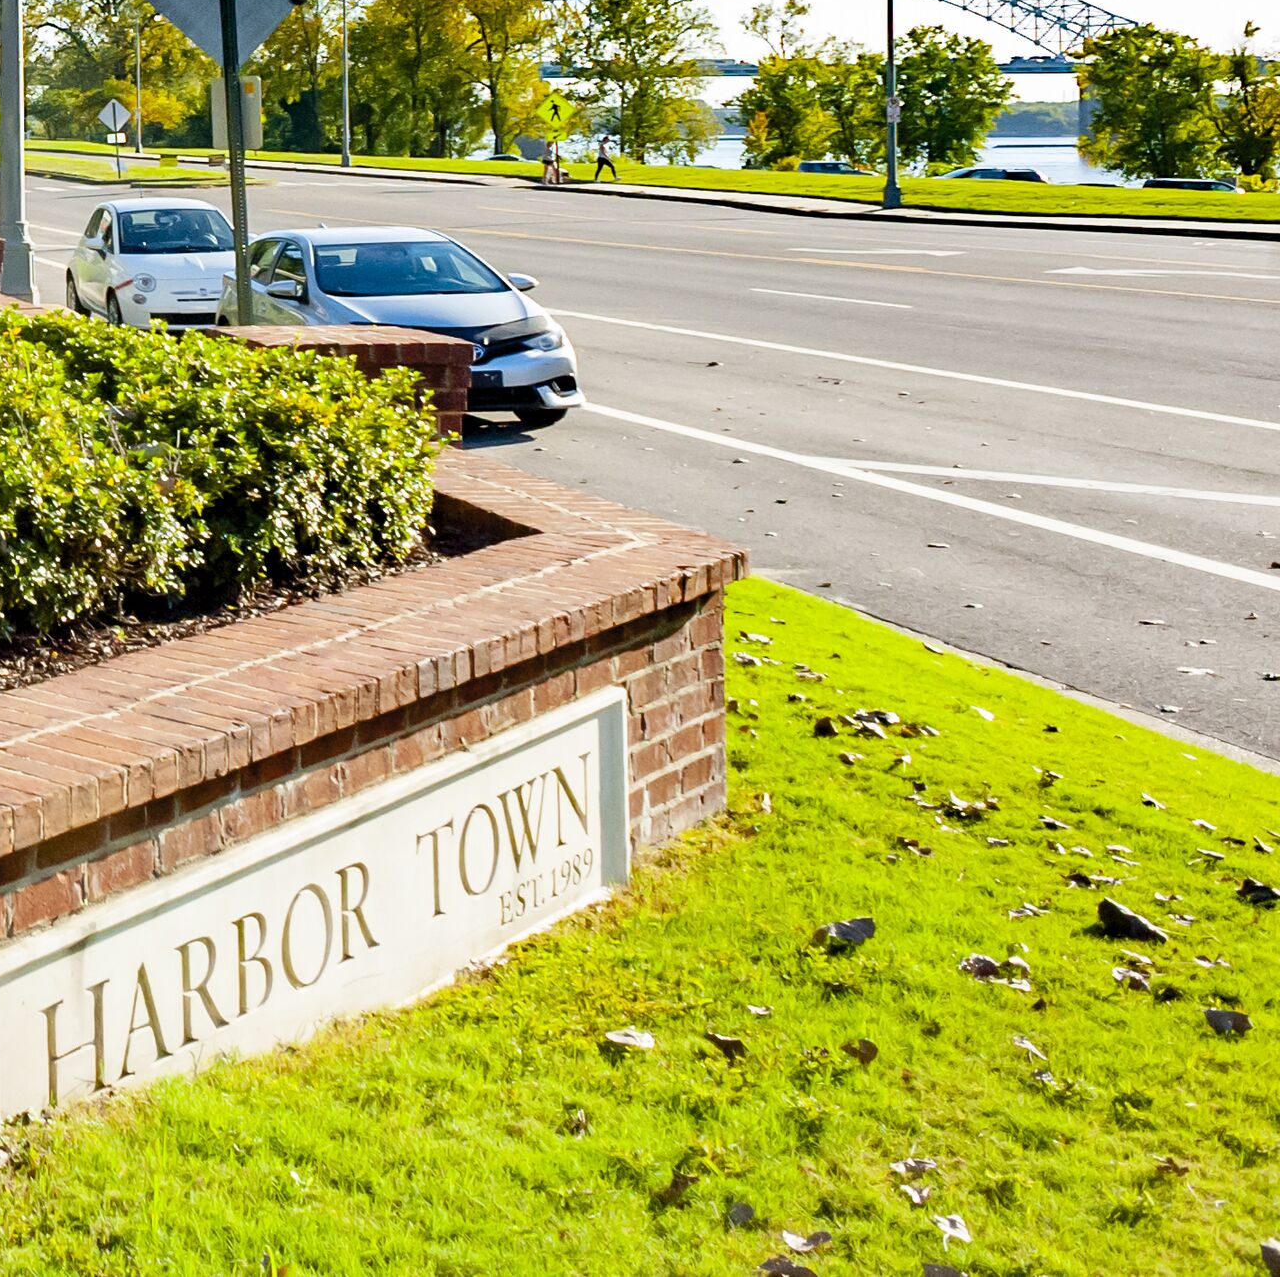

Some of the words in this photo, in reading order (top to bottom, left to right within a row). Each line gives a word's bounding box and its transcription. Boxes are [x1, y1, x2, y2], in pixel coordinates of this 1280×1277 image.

[40, 860, 380, 1107] HARBOR
[416, 752, 590, 918] TOWN
[499, 874, 545, 926] EST.
[550, 848, 593, 897] 1989
